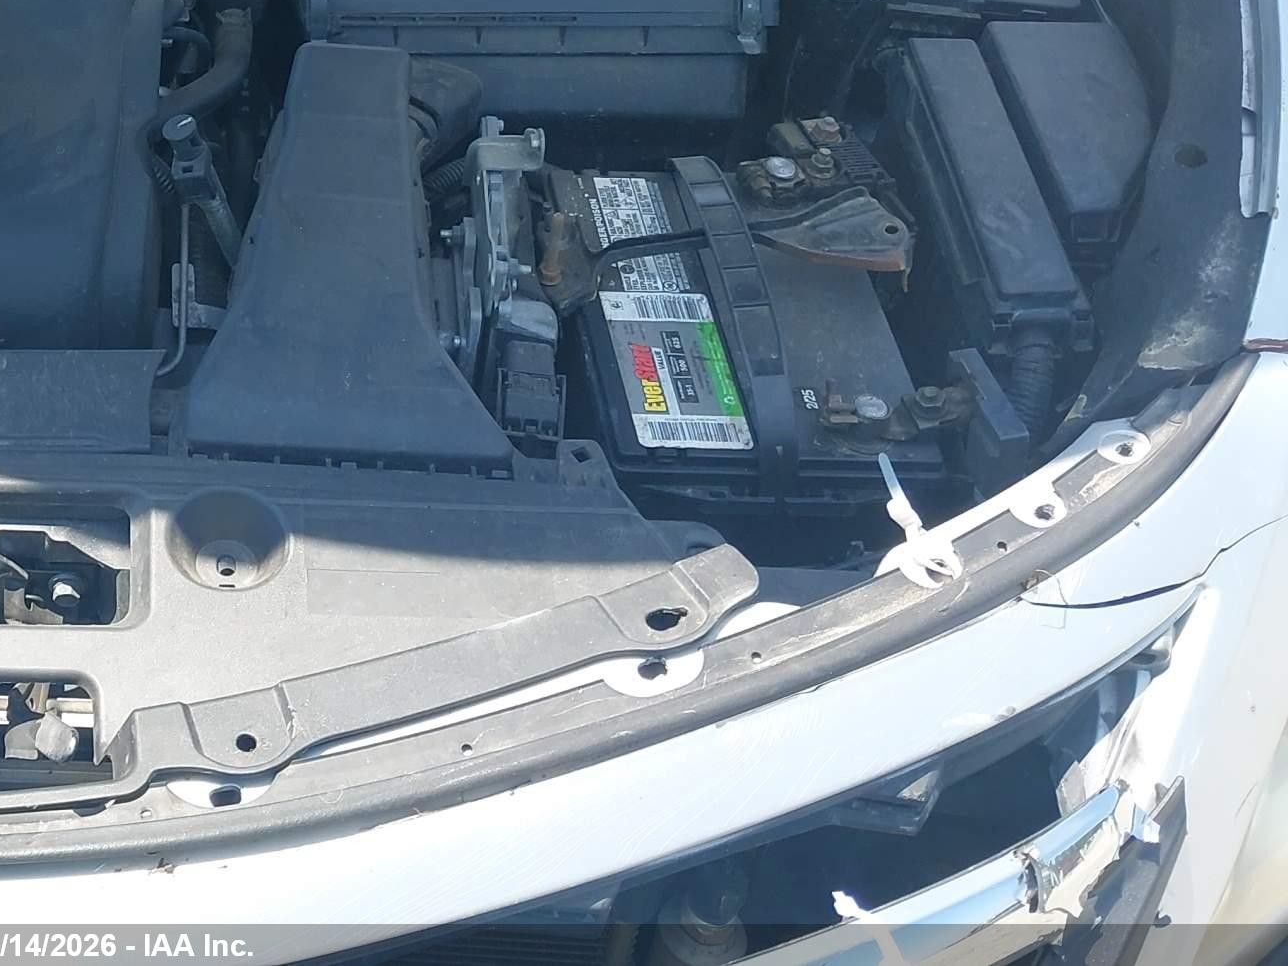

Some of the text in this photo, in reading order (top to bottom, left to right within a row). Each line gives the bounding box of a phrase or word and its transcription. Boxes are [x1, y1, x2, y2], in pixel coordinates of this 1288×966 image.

[589, 197, 605, 227] POISON
[655, 350, 666, 370] VALUE
[629, 342, 668, 412] EverStart
[801, 389, 818, 410] 2/25
